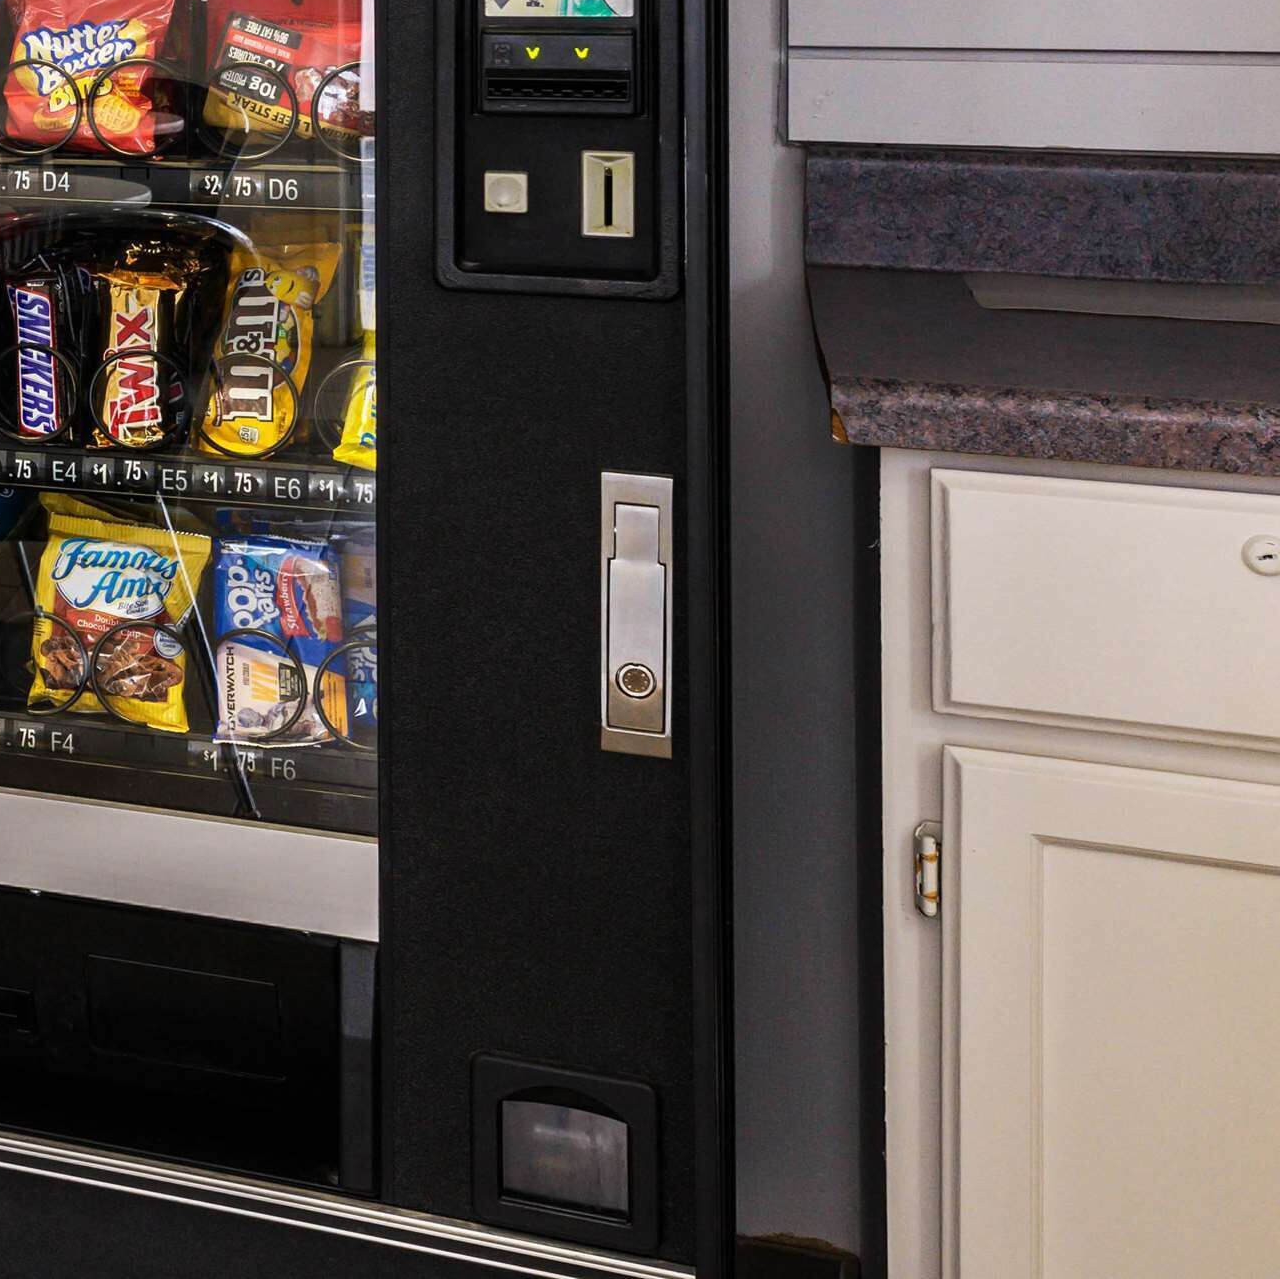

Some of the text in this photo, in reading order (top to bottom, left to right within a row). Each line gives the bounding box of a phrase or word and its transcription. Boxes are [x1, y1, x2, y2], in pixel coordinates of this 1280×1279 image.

[25, 20, 129, 61] Nutter
[38, 37, 138, 95] Butter
[233, 94, 271, 118] STEAK
[269, 179, 297, 200] D6
[16, 289, 59, 437] SNICKERS
[109, 307, 162, 437] TWIX
[52, 462, 77, 481] E4
[274, 479, 301, 499] E6
[51, 538, 178, 581] Famous
[278, 572, 298, 630] Strawberry
[225, 646, 237, 731] OVERWATCH
[51, 733, 74, 753] F4
